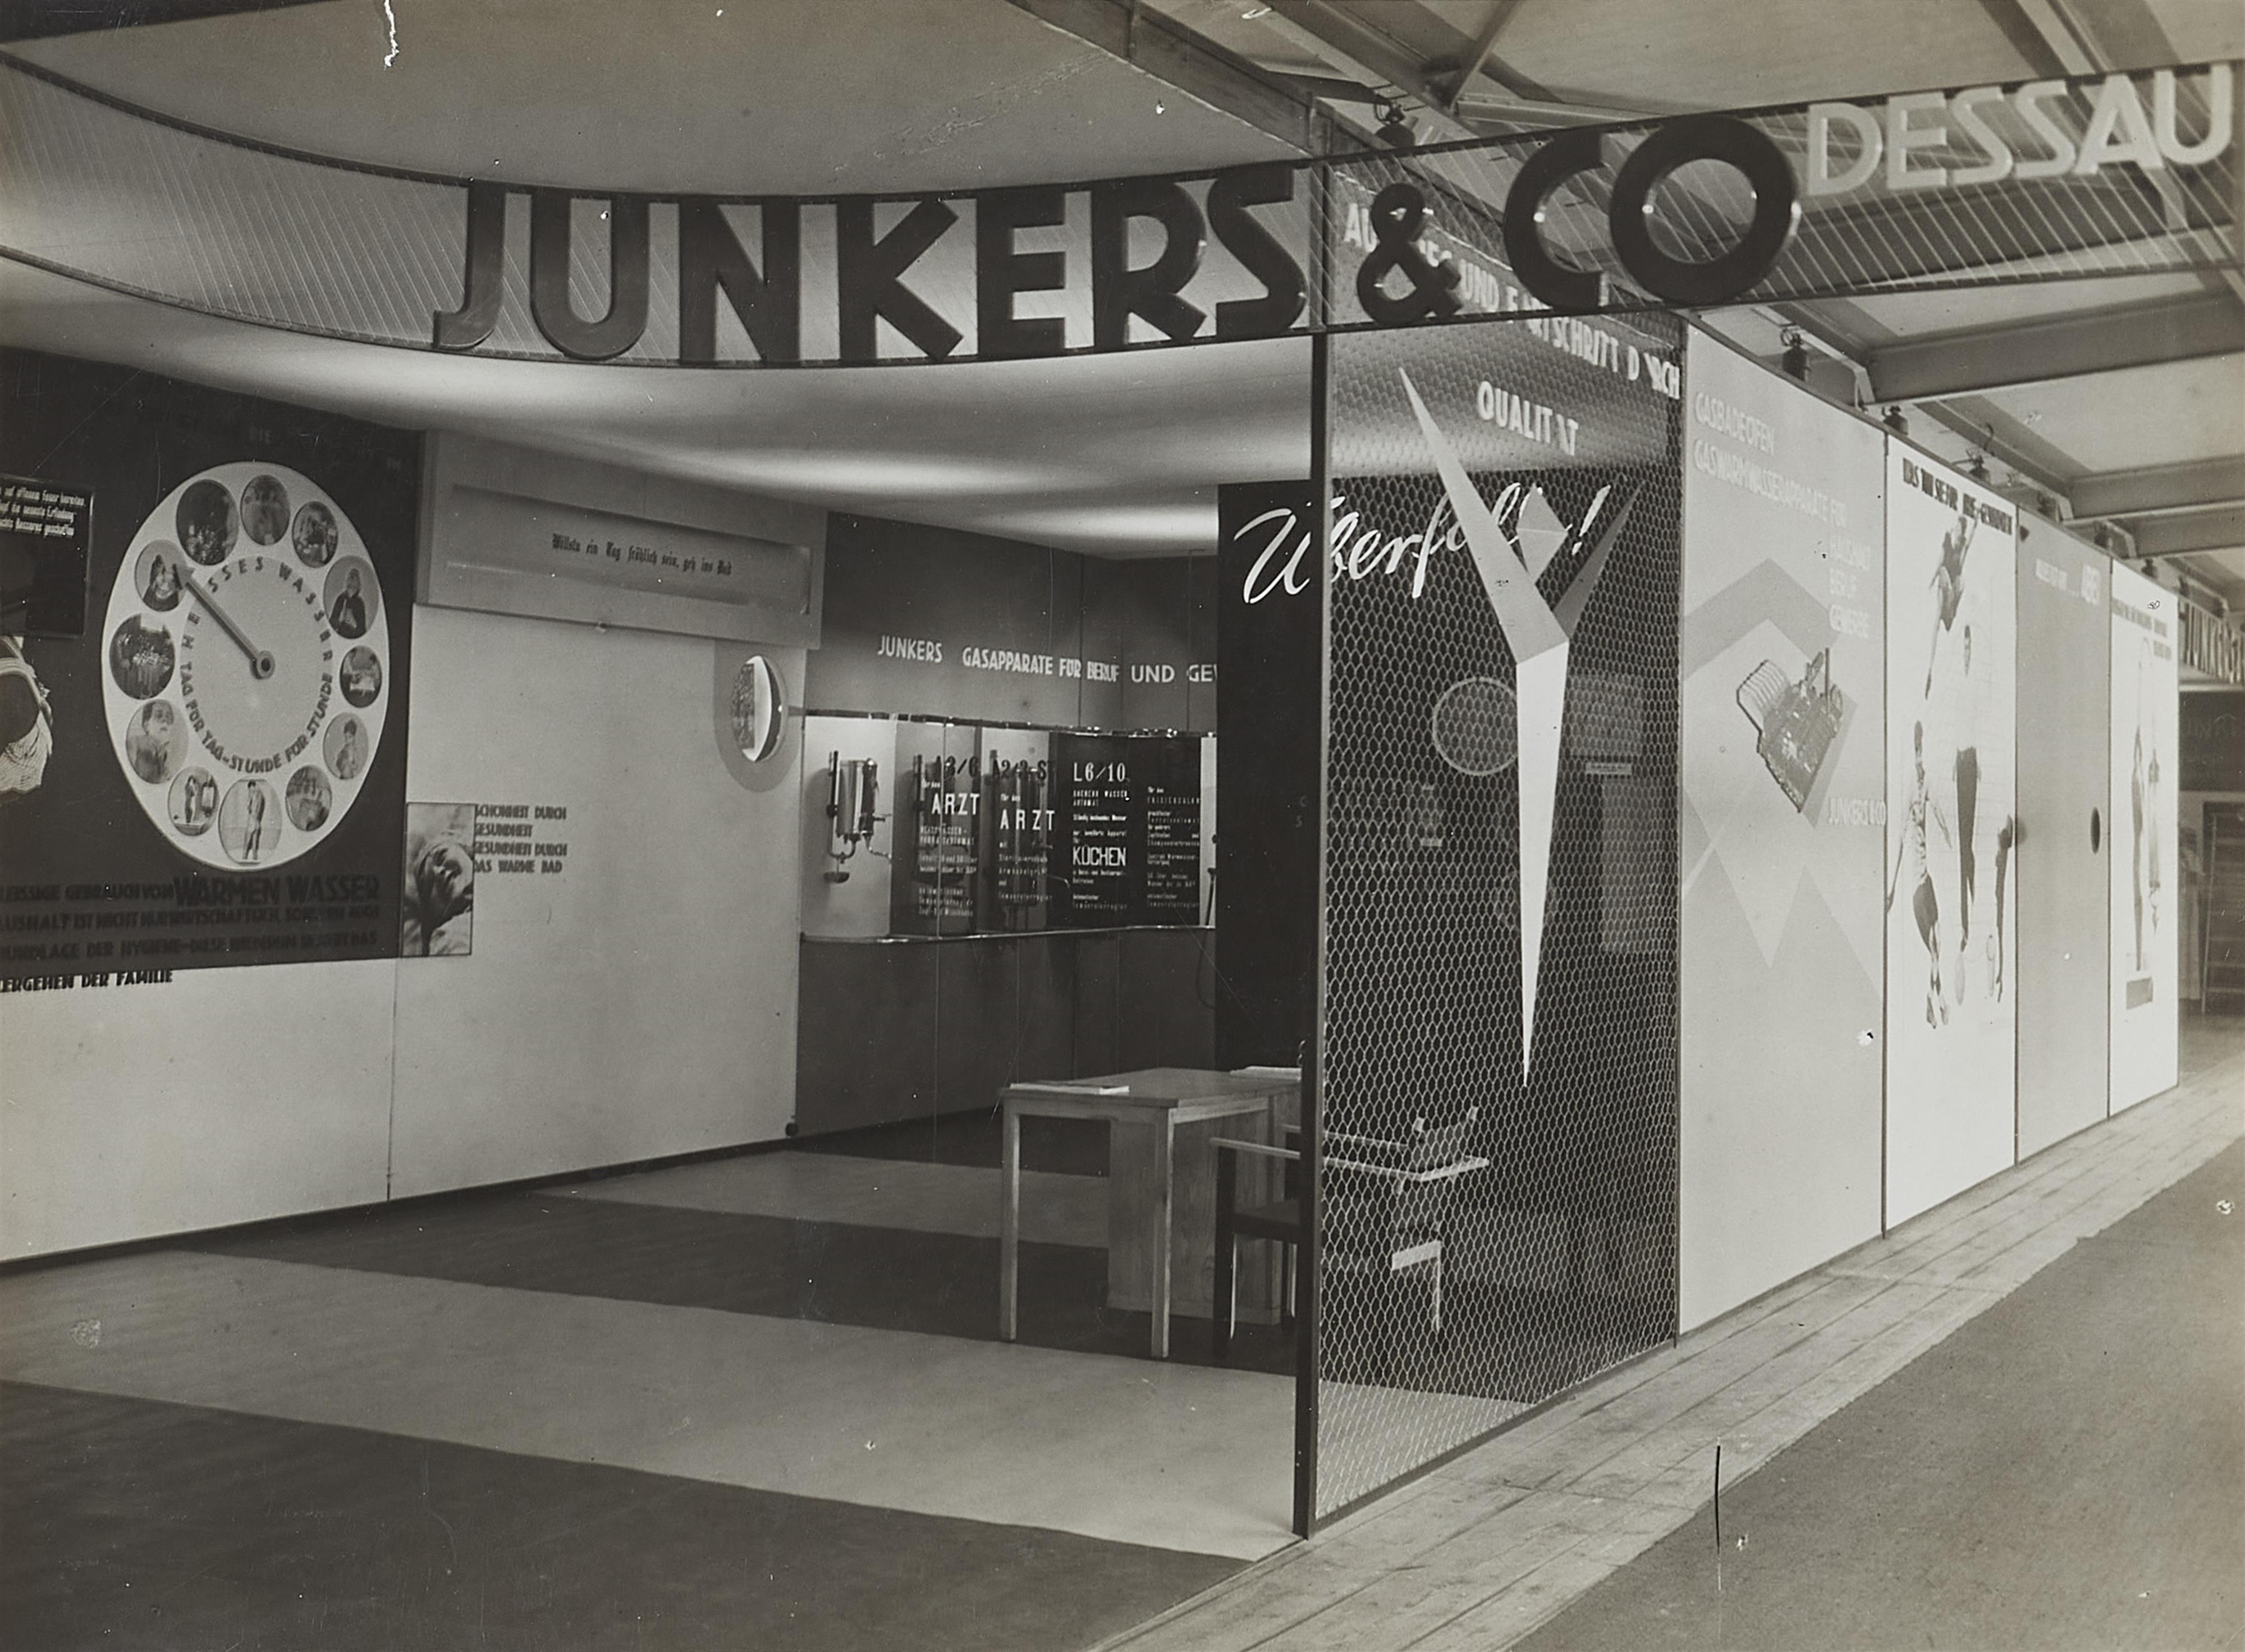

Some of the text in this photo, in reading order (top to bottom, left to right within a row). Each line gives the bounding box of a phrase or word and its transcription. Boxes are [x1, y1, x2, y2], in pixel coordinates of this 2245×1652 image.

[433, 63, 2233, 366] JUNKERS & CO DESSAU
[877, 635, 943, 663] JUNKERS
[962, 647, 1053, 675] GASAPPARATE
[1131, 664, 1175, 683] UND
[1188, 664, 1217, 683] GE
[1073, 761, 1126, 782] L6/10
[931, 792, 981, 816] ARZT
[1000, 809, 1055, 831] ARZT
[1073, 845, 1126, 866] KÜCHEN
[541, 860, 563, 873] BAD
[81, 972, 109, 988] DER
